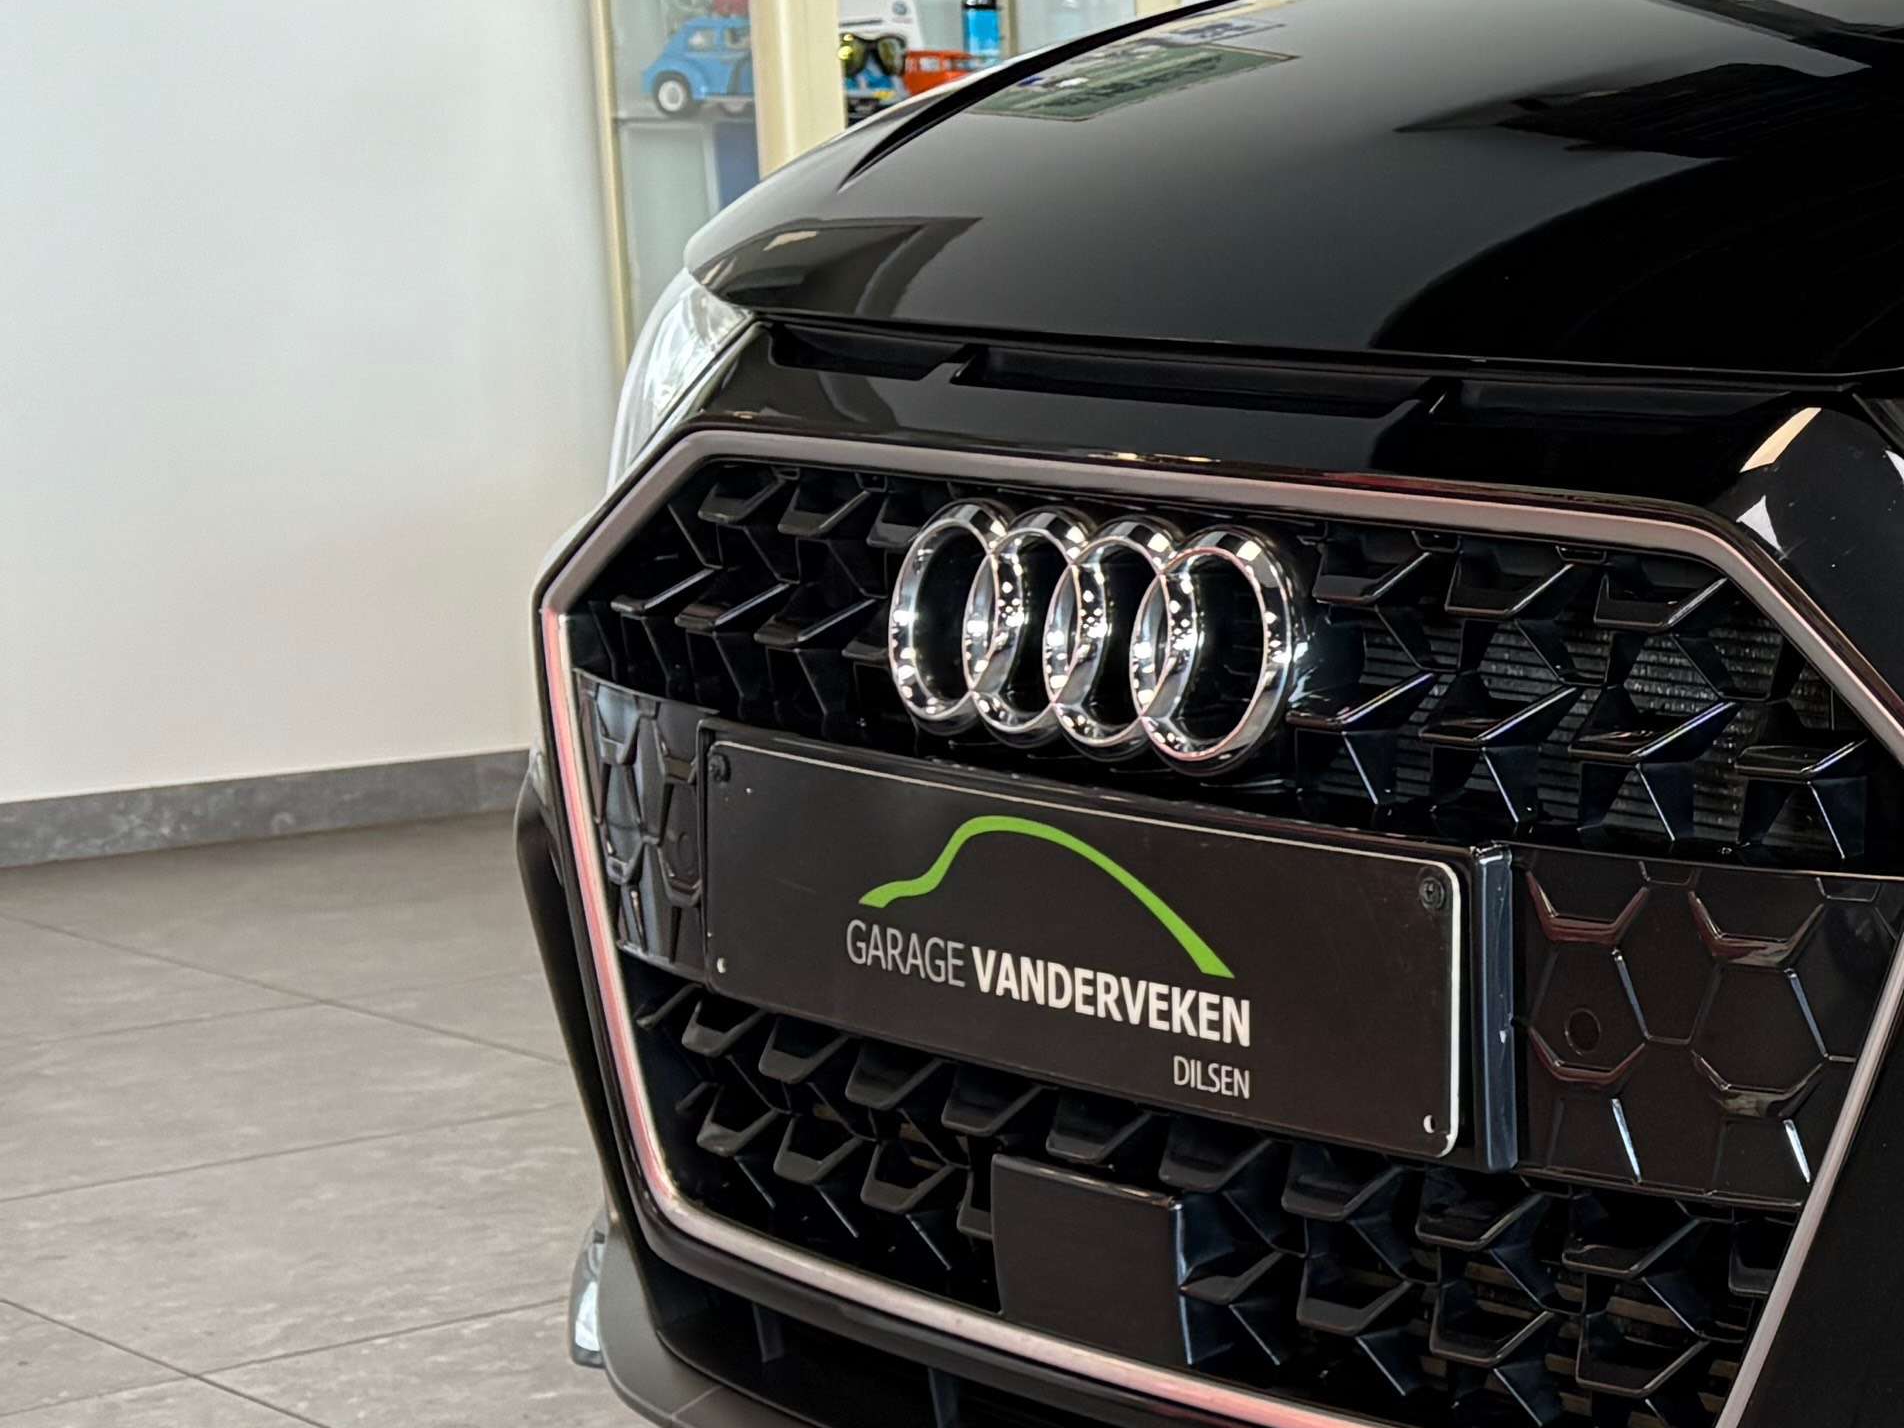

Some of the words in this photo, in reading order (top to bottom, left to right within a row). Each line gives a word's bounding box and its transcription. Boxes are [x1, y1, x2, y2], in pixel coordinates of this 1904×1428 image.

[846, 918, 966, 988] GARAGE
[972, 945, 1251, 1048] VANDERVEKEN
[1173, 1055, 1251, 1100] DILSEN
